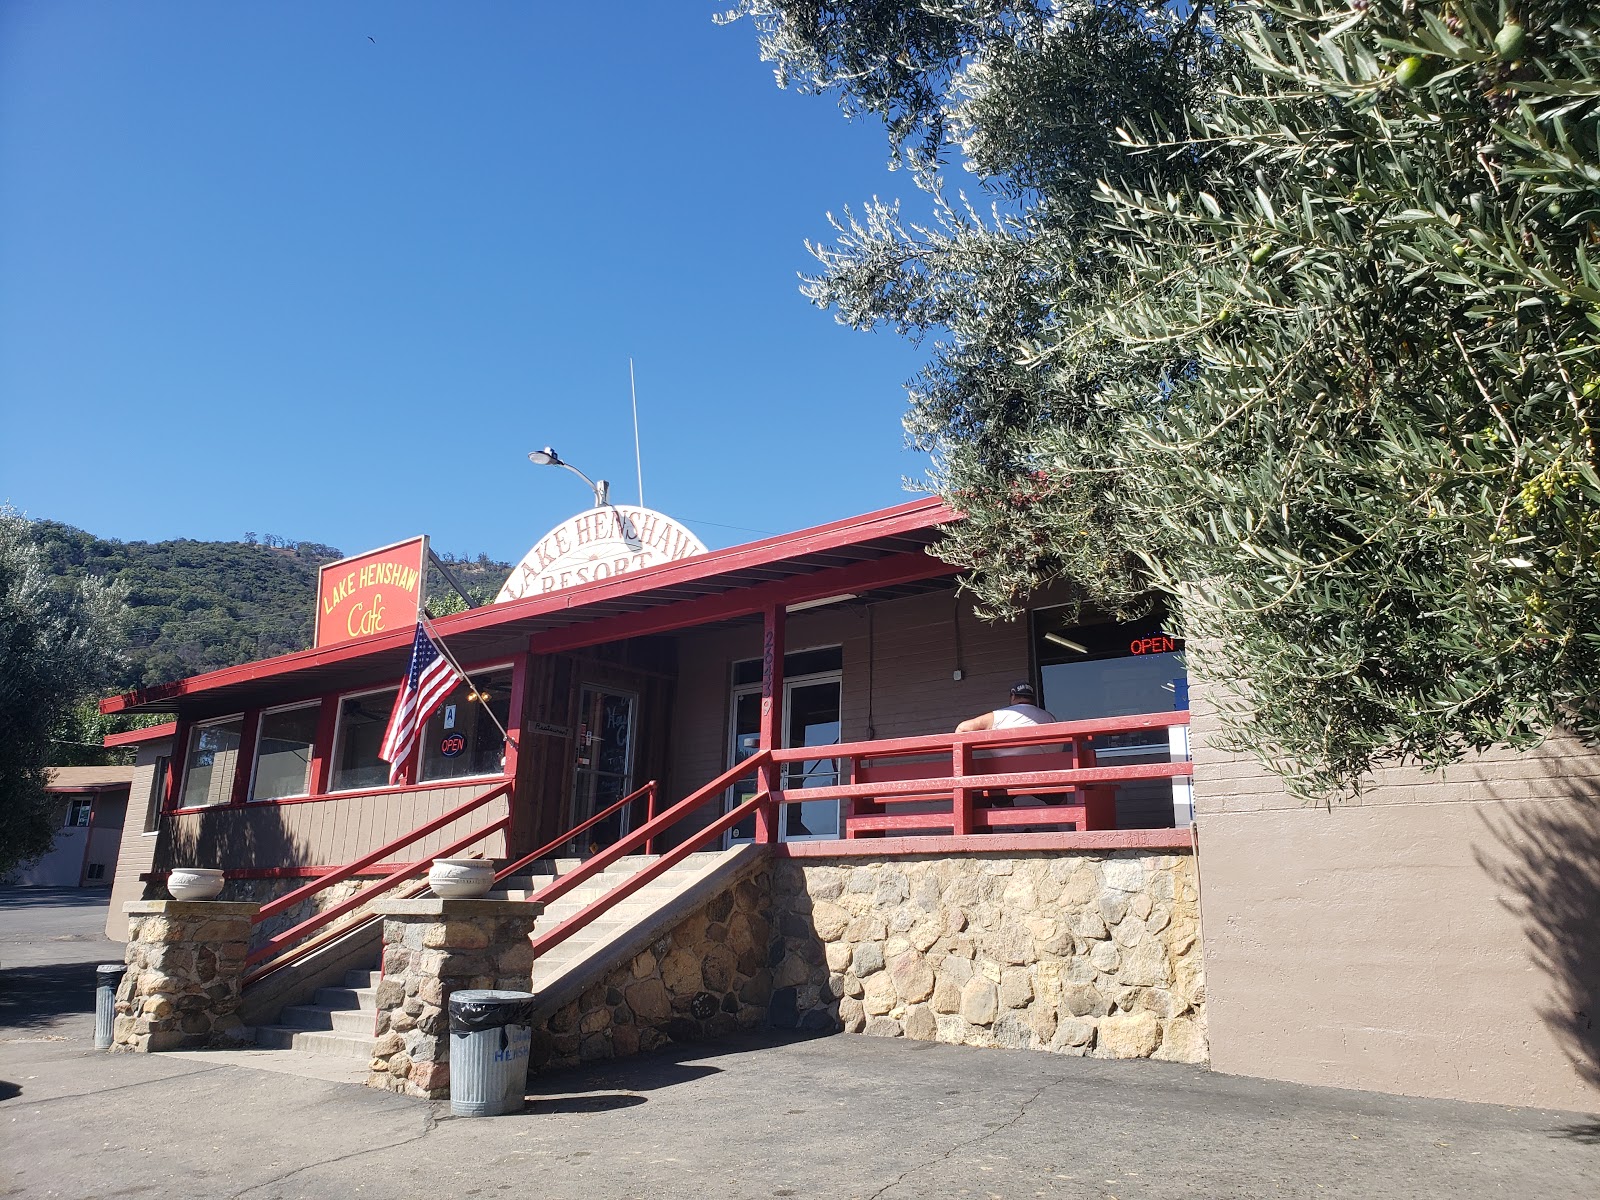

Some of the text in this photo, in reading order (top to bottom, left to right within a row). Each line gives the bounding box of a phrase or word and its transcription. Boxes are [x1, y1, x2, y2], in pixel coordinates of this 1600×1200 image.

[503, 510, 699, 600] LAKE HENSHAW
[541, 552, 653, 593] RESORT
[323, 563, 419, 615] LAKE HENSHAW
[347, 593, 385, 636] Cafe
[1130, 637, 1175, 654] OPEN
[446, 708, 453, 721] A
[441, 738, 465, 752] OPEN
